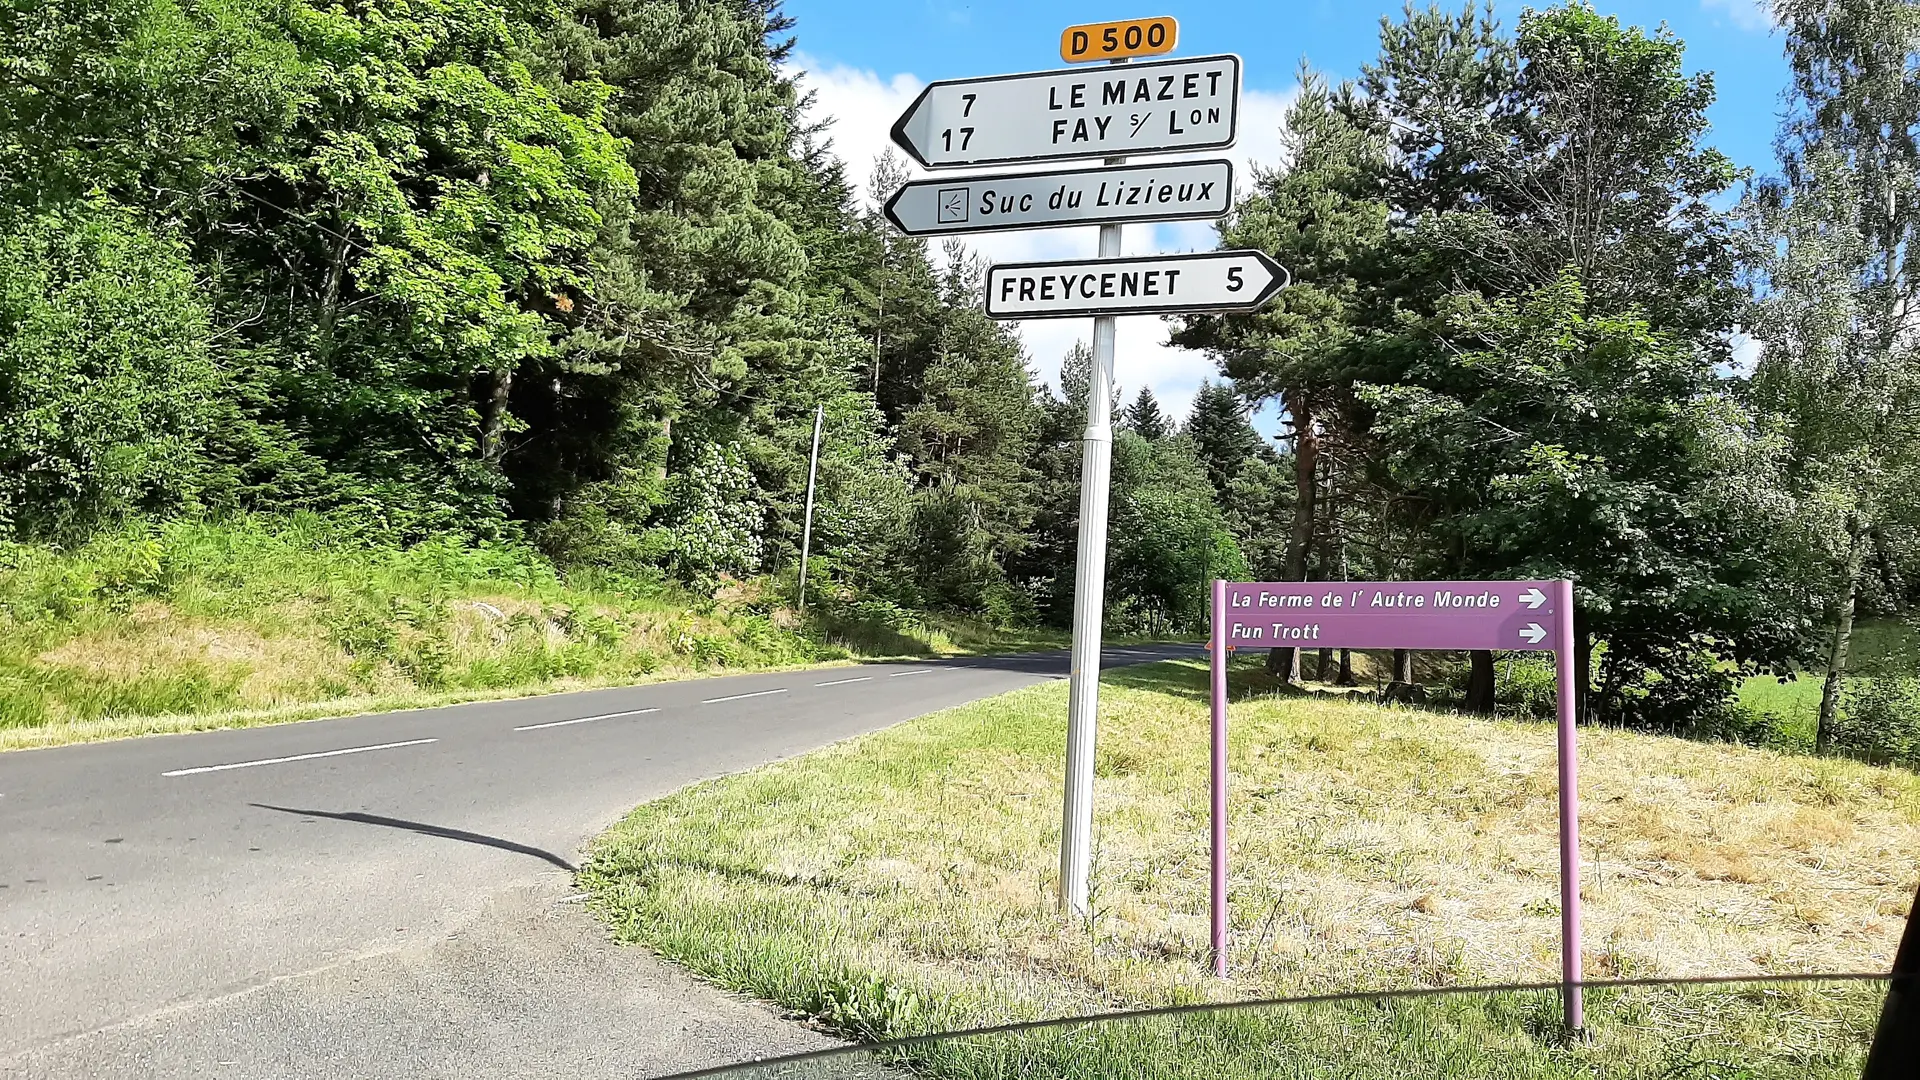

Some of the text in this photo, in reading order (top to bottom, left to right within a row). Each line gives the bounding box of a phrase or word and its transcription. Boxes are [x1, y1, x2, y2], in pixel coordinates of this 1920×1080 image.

[1071, 23, 1165, 55] D 500
[1049, 71, 1223, 110] LE MAZET
[961, 94, 976, 117] 7
[942, 128, 975, 152] 17
[1052, 116, 1112, 144] FAY
[979, 180, 1215, 215] Suc du Lizieux
[1001, 270, 1181, 302] FREYCENET
[1227, 267, 1243, 292] 5
[1232, 591, 1251, 607] La
[1258, 591, 1313, 608] Ferme
[1322, 591, 1342, 608] de
[1371, 591, 1424, 608] Autre
[1433, 591, 1501, 608] Monde
[1232, 623, 1320, 640] Fun Trott
